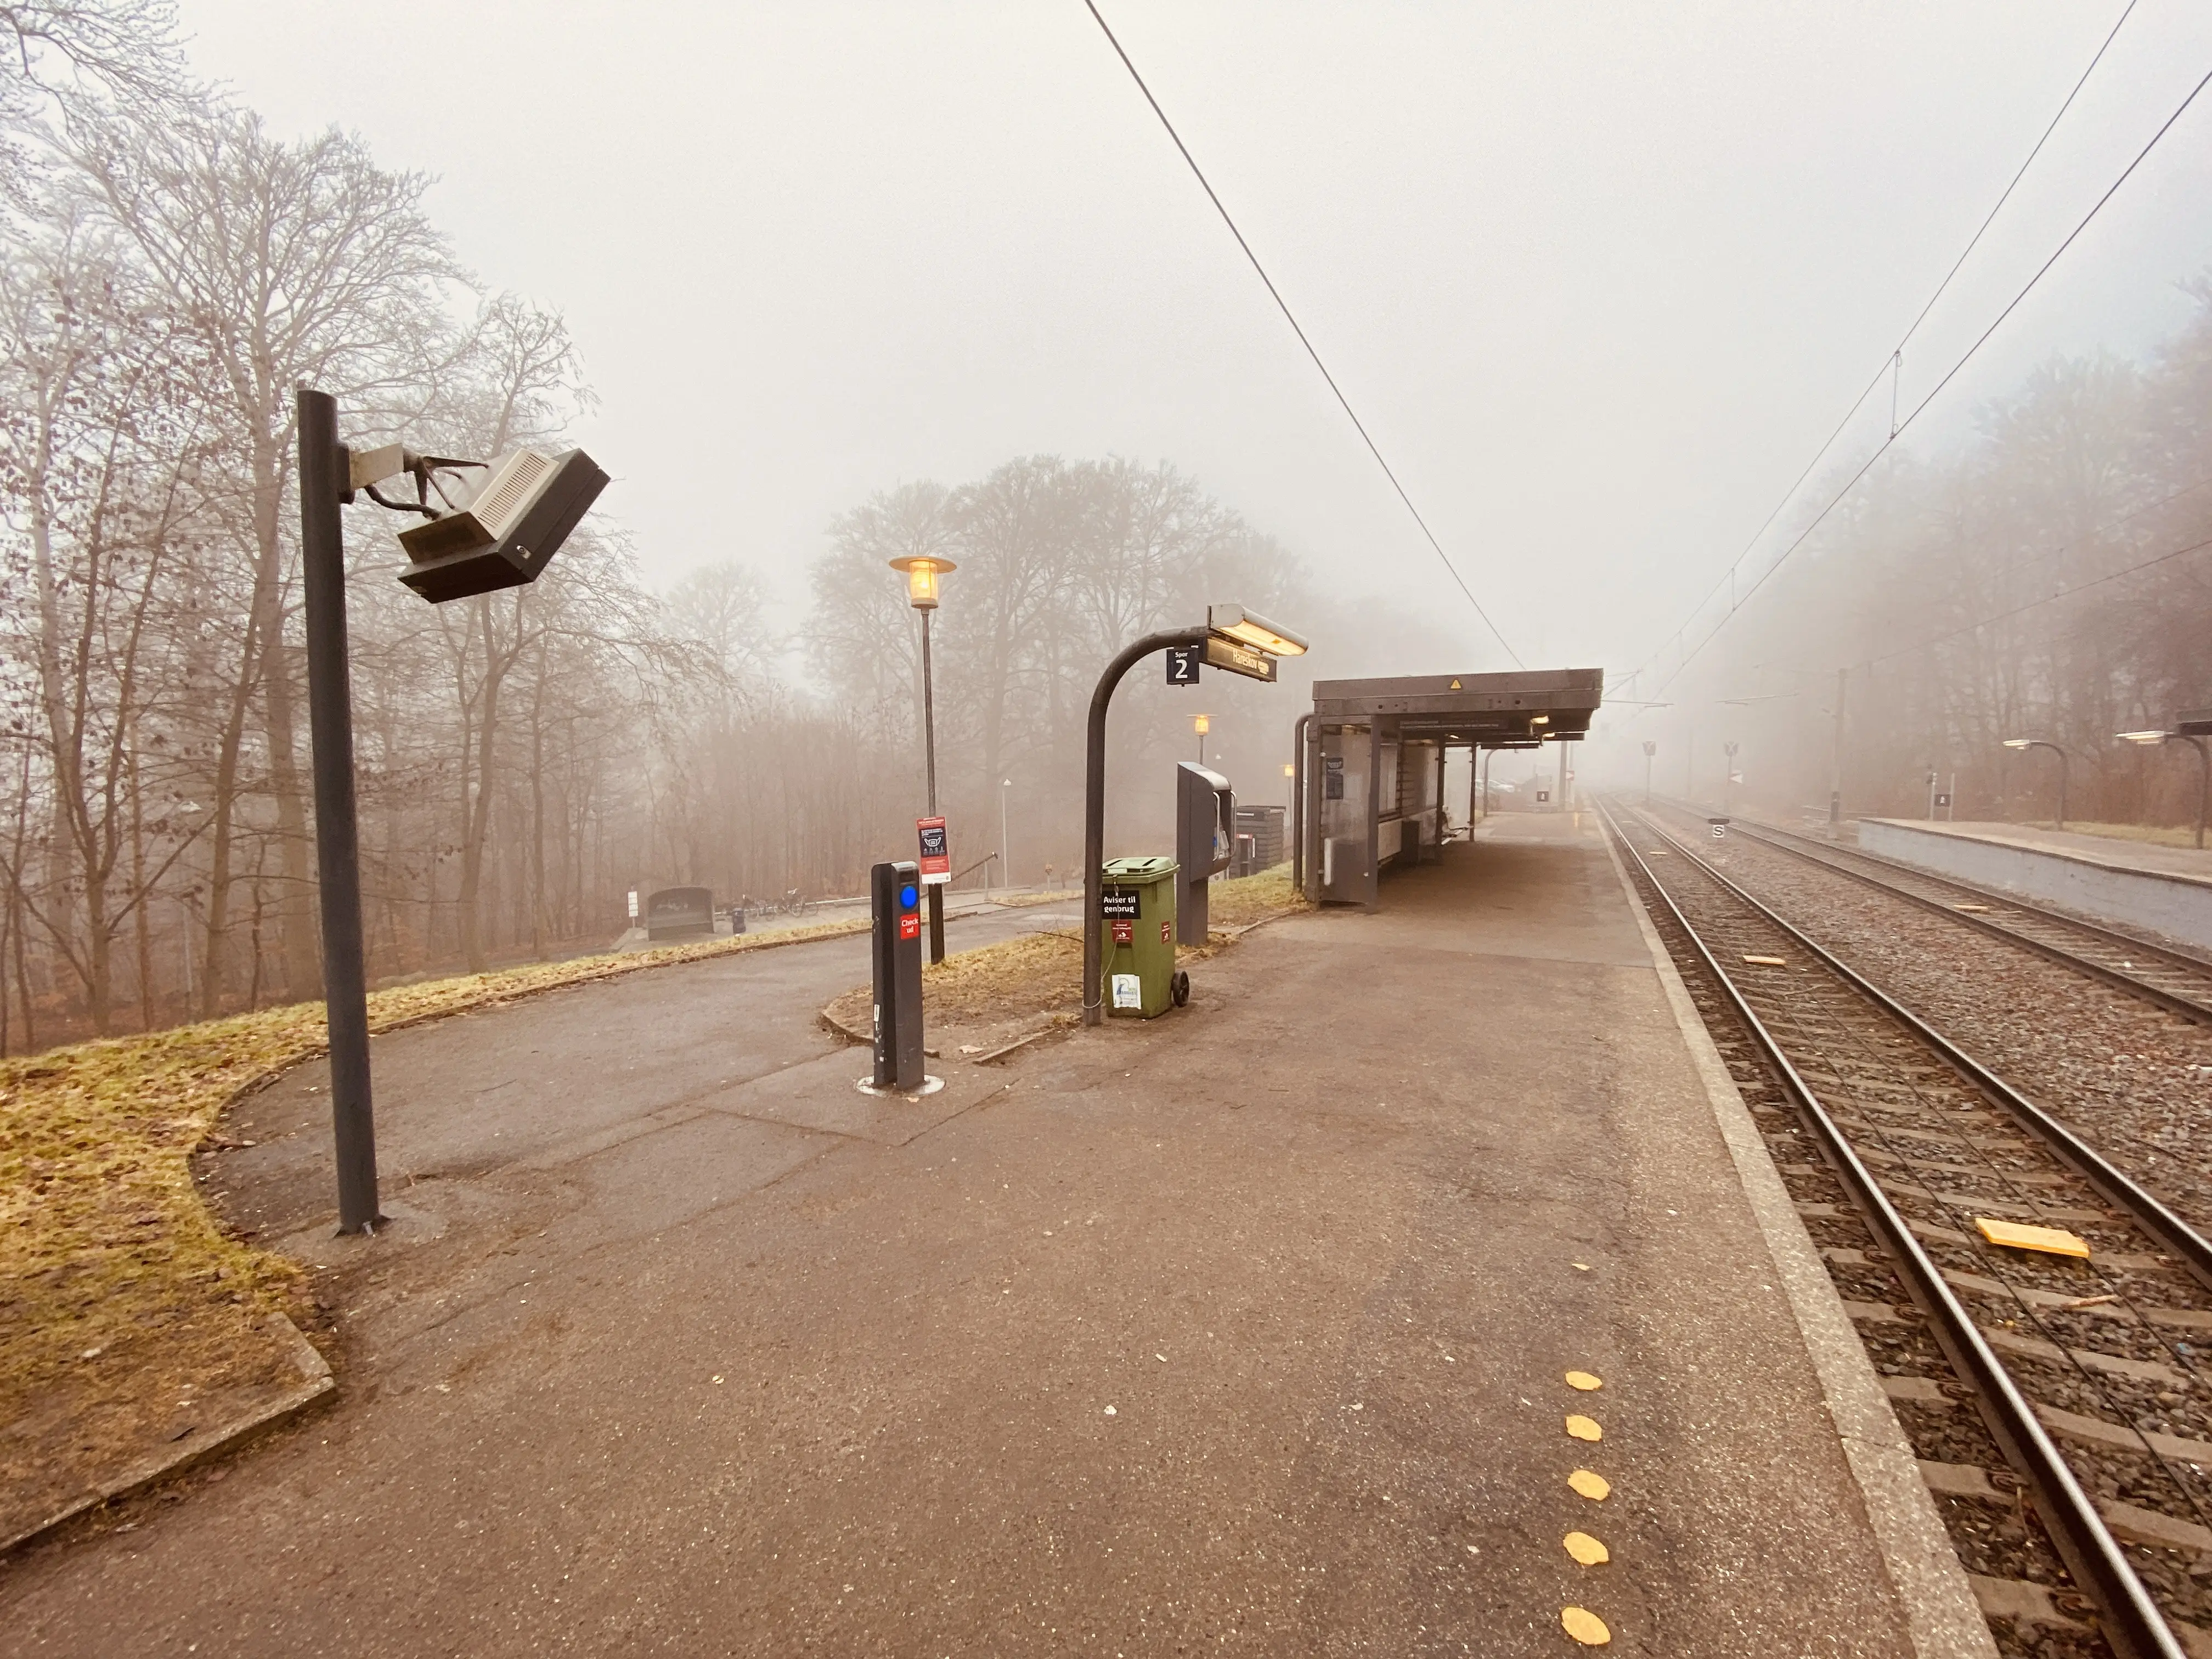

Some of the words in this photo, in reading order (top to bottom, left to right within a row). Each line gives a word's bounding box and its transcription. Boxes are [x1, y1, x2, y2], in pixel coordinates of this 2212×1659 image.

[1175, 659, 1188, 679] 2
[1714, 826, 1723, 836] S
[1127, 895, 1136, 904] til
[1104, 905, 1135, 913] genbrug
[902, 918, 918, 926] Check
